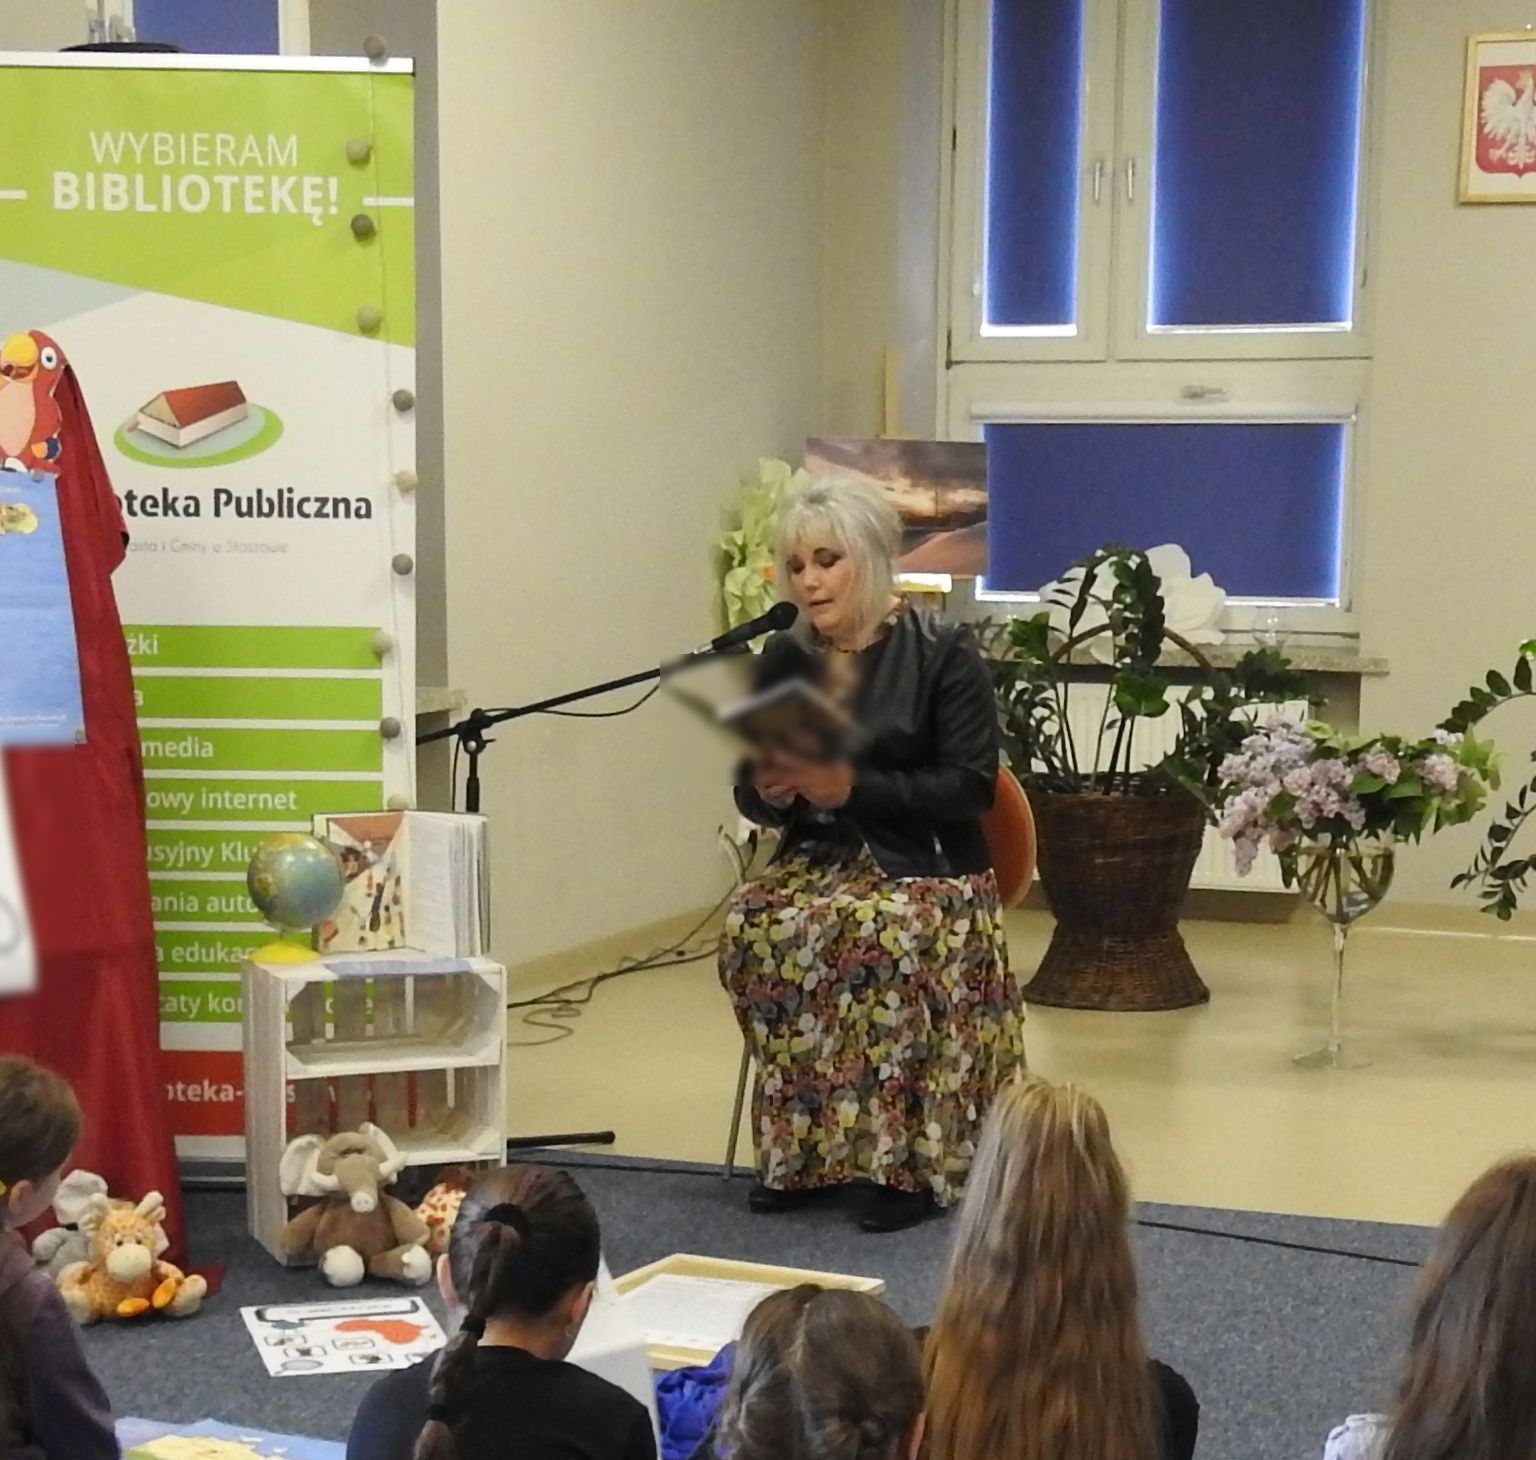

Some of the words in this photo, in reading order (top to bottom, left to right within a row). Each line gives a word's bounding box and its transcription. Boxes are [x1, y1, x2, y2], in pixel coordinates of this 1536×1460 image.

[89, 131, 299, 168] WYBIERAM
[53, 171, 340, 226] BIBLIOTEKĘ!
[119, 486, 201, 517] teka
[213, 486, 373, 519] Publiczna
[141, 736, 214, 758] media
[145, 791, 194, 815] owy
[201, 787, 298, 811] internet
[221, 840, 264, 862] Klu
